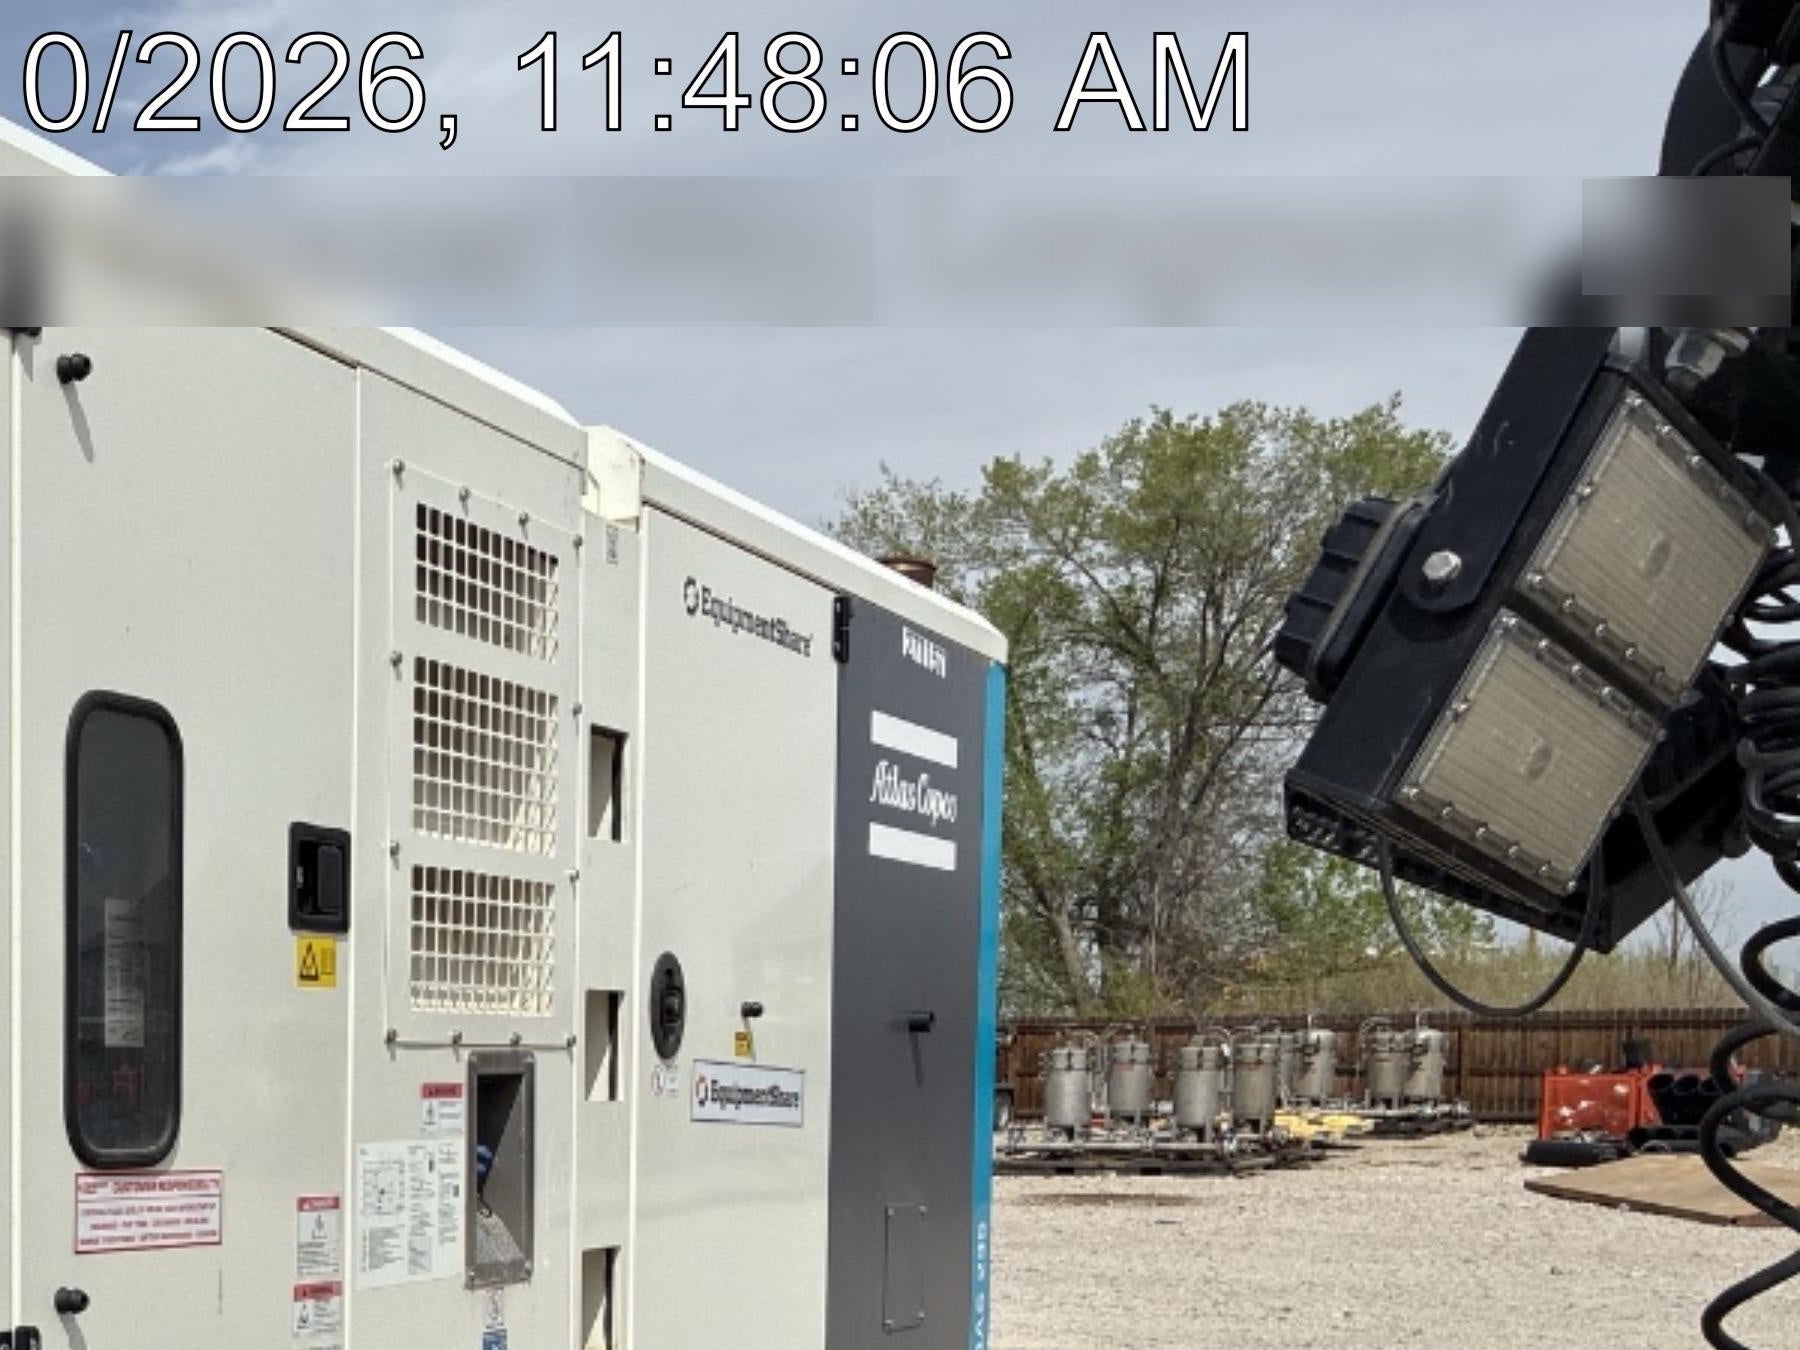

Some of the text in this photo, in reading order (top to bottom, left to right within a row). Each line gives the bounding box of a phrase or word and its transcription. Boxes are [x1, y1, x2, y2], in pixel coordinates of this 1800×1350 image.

[702, 585, 811, 657] EquipmentShare
[869, 760, 957, 825] Atlas Copco
